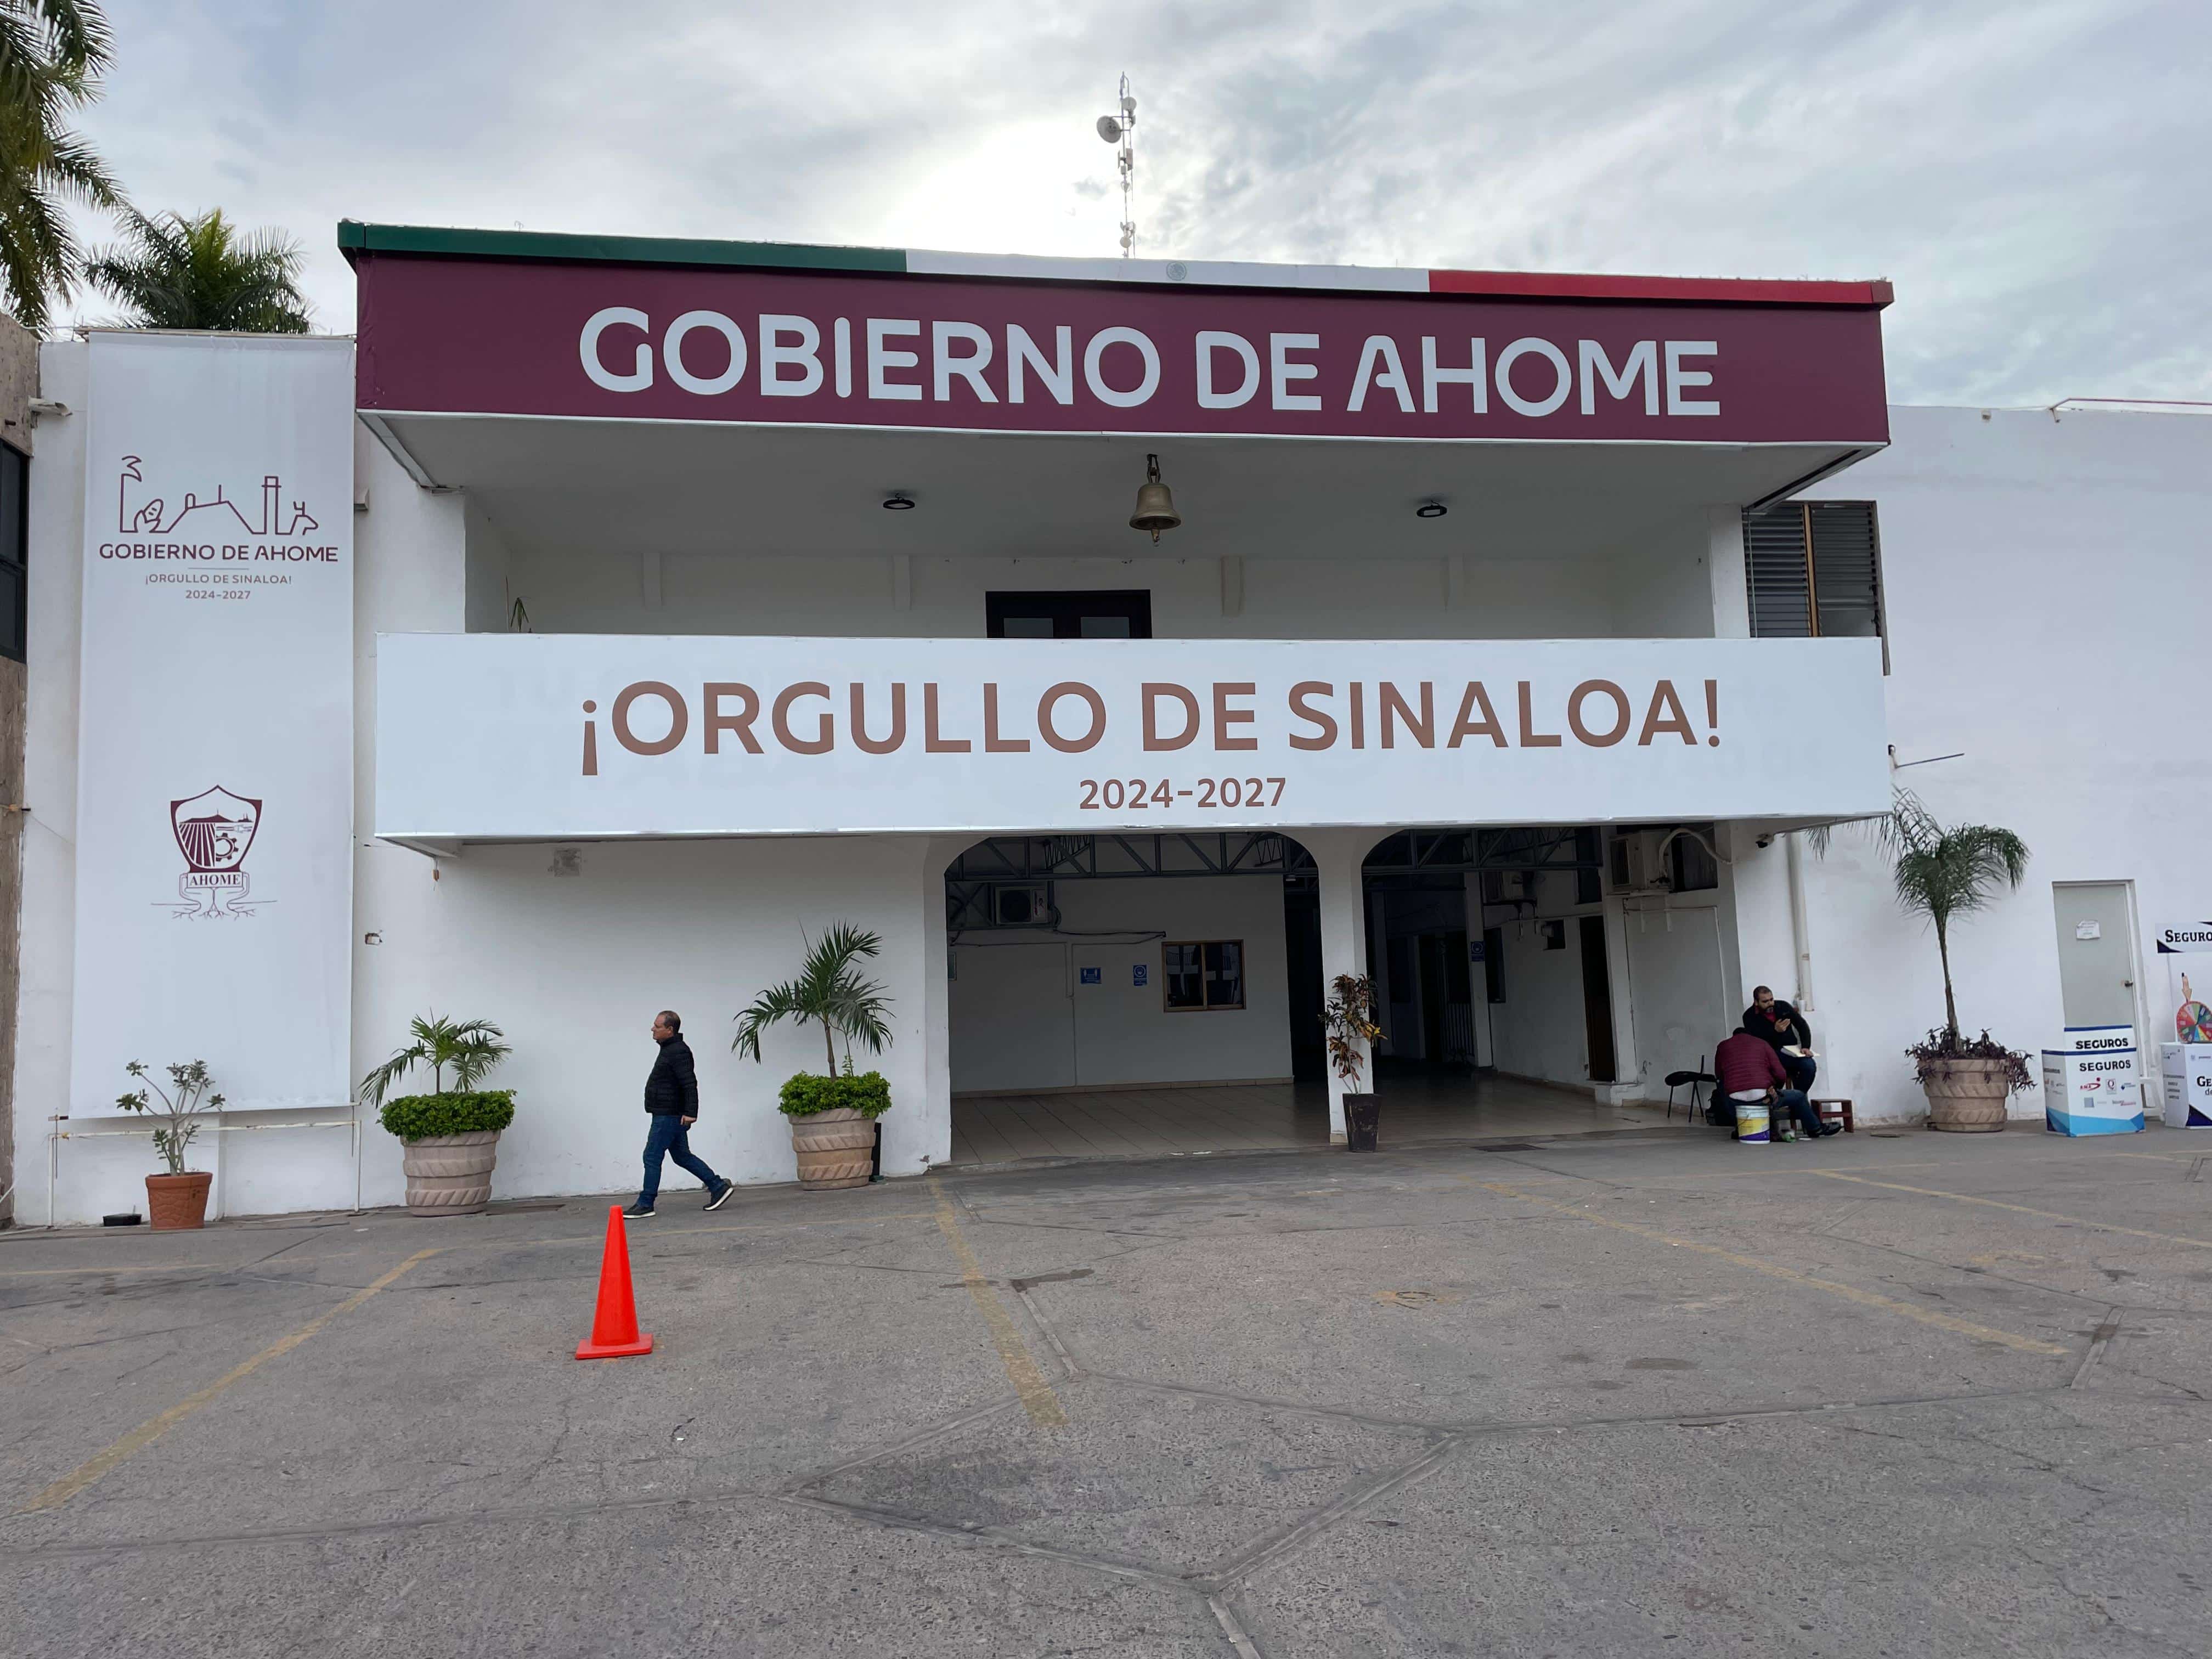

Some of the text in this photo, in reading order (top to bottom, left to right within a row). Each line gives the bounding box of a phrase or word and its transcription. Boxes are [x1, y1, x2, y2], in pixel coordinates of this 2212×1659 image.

[579, 306, 1720, 417] GOBIERNO DE AHOME
[99, 543, 338, 562] GOBIERNO DE AHOME
[145, 573, 292, 585] ¡ORGULLO DE SINALOA!
[185, 590, 251, 600] 2024-2027
[582, 679, 1720, 776] ¡ORGULLO DE SINALOA!
[1079, 777, 1287, 809] 2024-2027
[190, 874, 241, 886] AHOME
[2075, 1038, 2129, 1049] SEGUROS
[2079, 1059, 2131, 1071] SEGUROS
